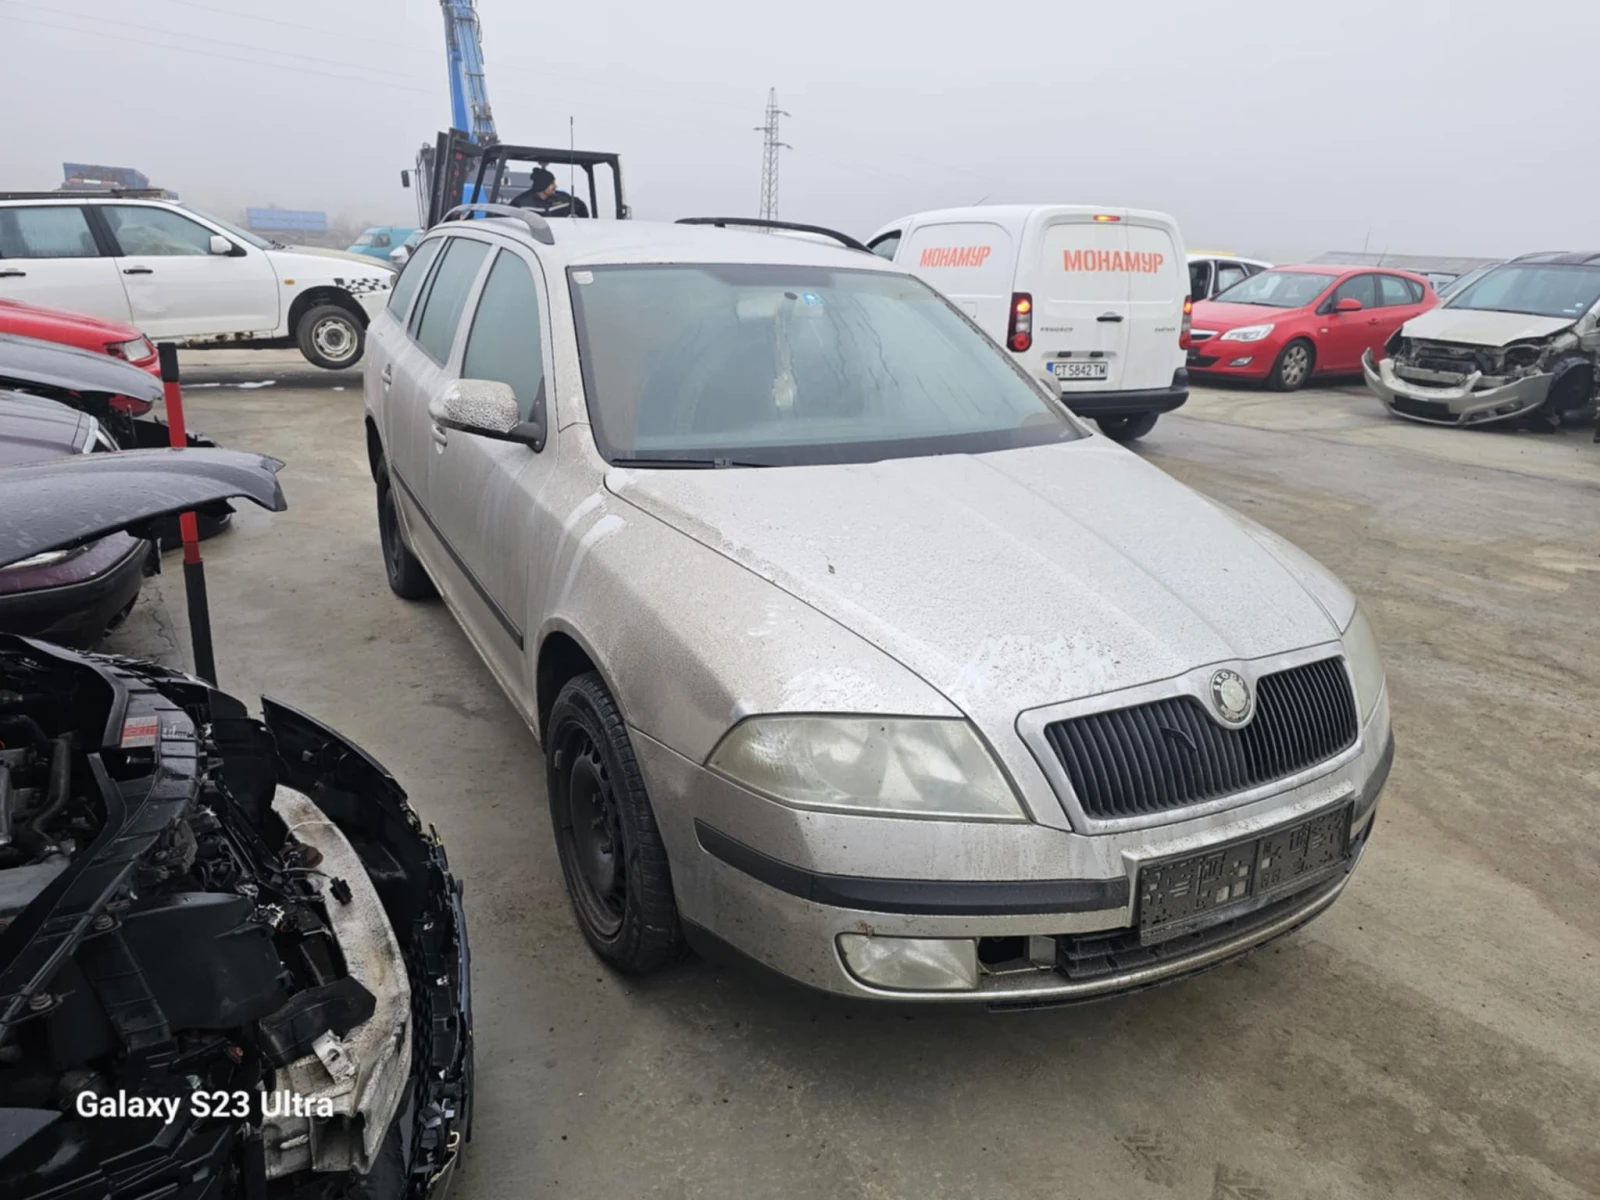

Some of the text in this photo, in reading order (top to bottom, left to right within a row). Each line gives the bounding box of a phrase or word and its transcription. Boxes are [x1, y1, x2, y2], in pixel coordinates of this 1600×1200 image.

[919, 245, 992, 268] МОНАМУР
[1063, 249, 1164, 274] МОНАМУР
[1068, 364, 1092, 376] 5842
